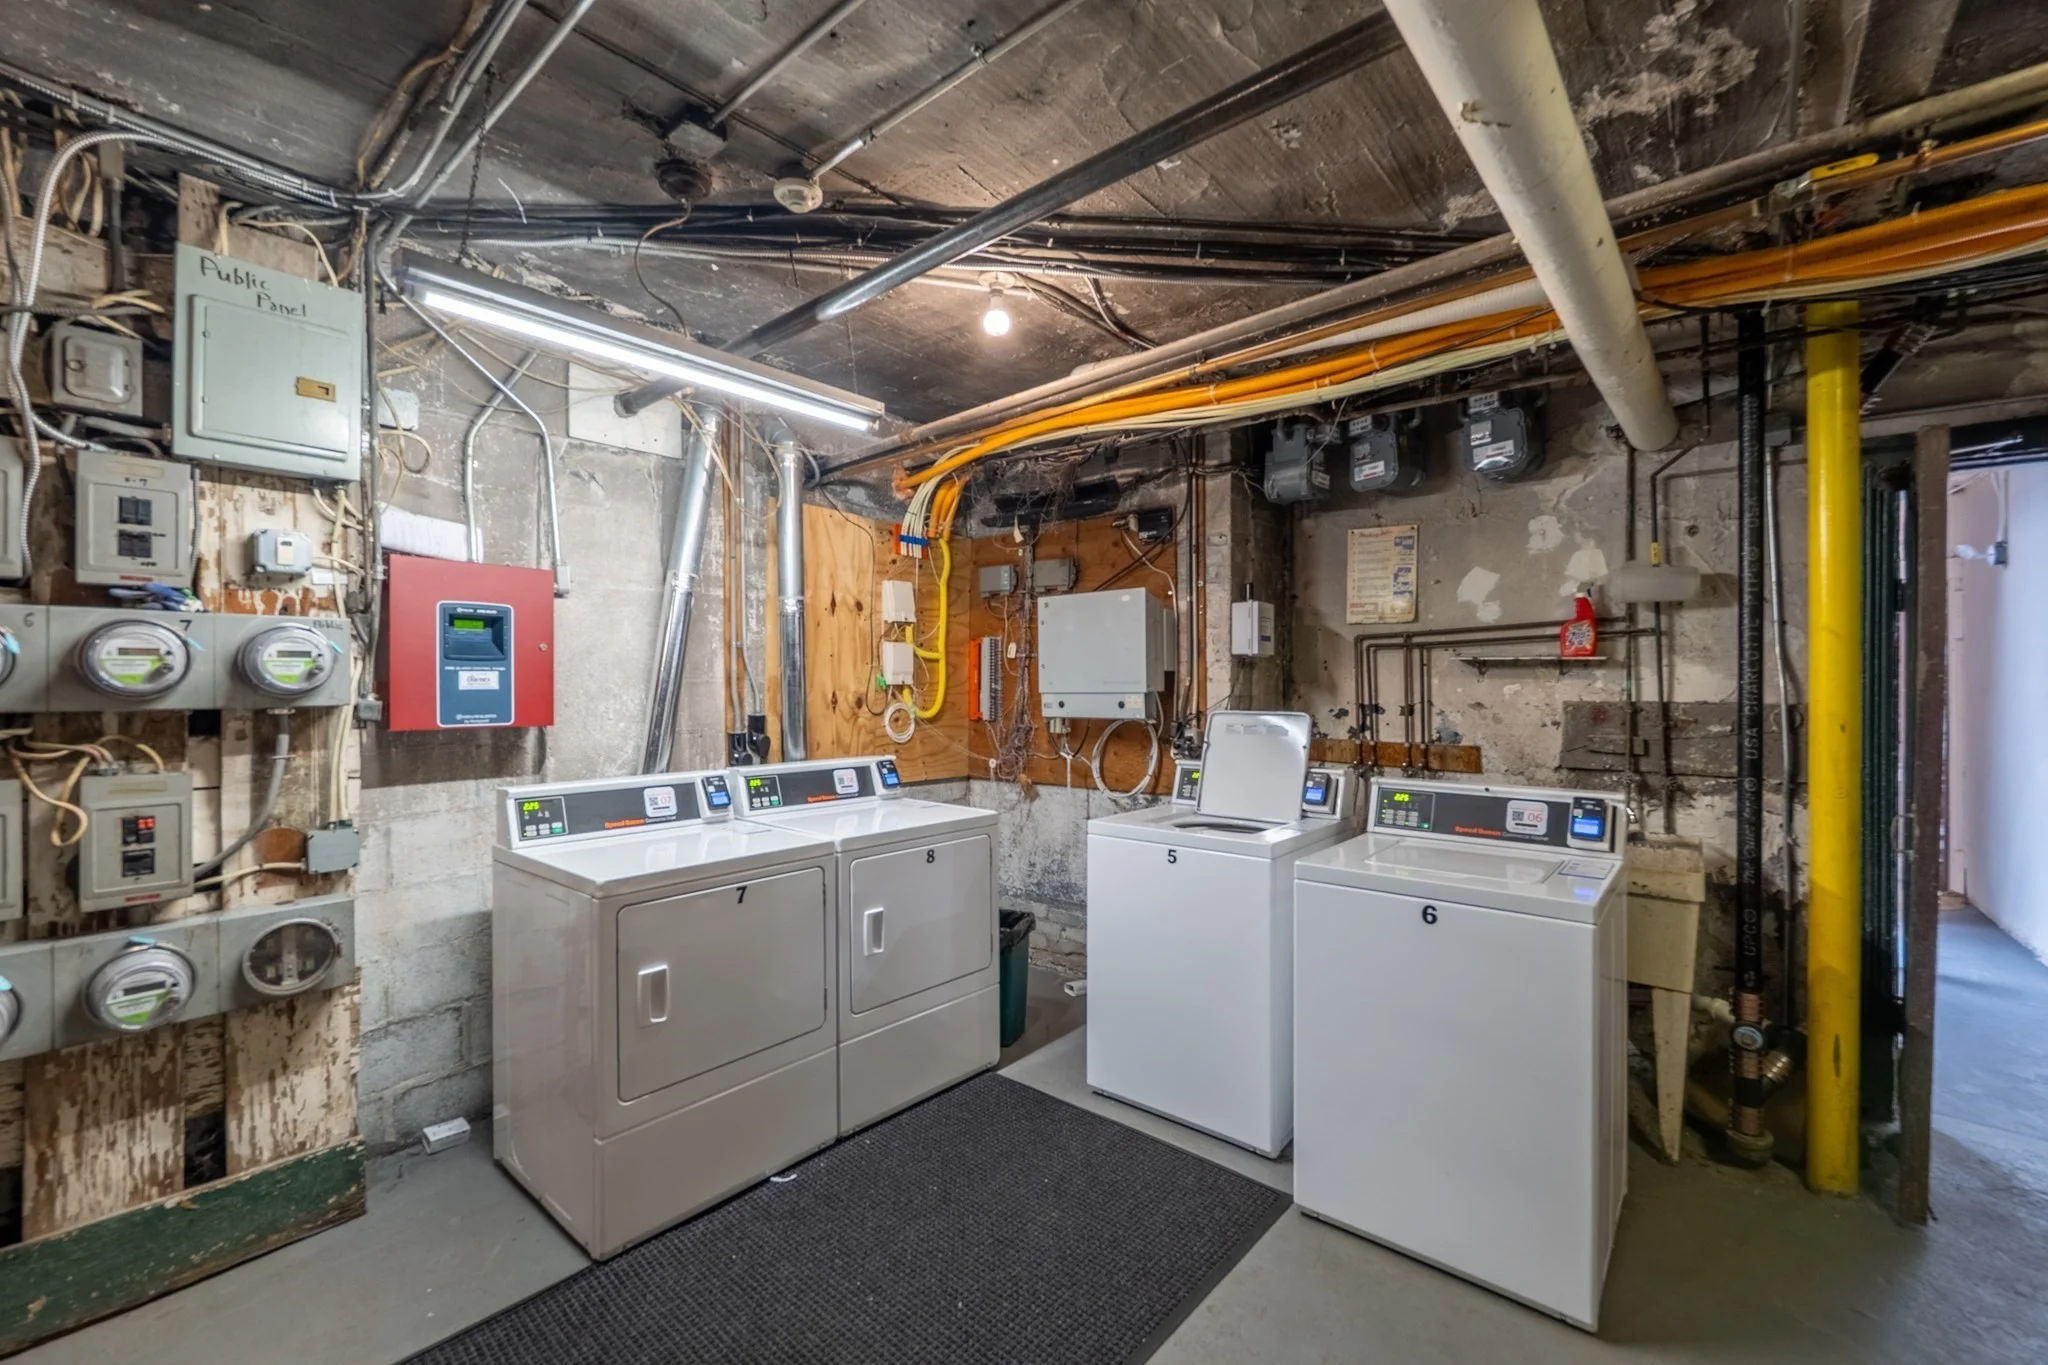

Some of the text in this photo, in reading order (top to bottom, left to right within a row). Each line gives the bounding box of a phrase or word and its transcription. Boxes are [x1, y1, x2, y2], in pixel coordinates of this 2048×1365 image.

[201, 256, 270, 291] Public
[257, 292, 306, 317] Panel
[24, 613, 34, 627] 6
[180, 619, 192, 631] 7
[1743, 618, 1759, 716] CHARLOTTE
[1743, 728, 1759, 760] USA
[1393, 793, 1409, 802] 225
[1527, 812, 1544, 823] 06
[1455, 826, 1478, 834] Speed
[926, 849, 935, 864] 8
[1167, 850, 1177, 864] 5
[736, 886, 748, 903] 7
[1421, 904, 1438, 925] 6
